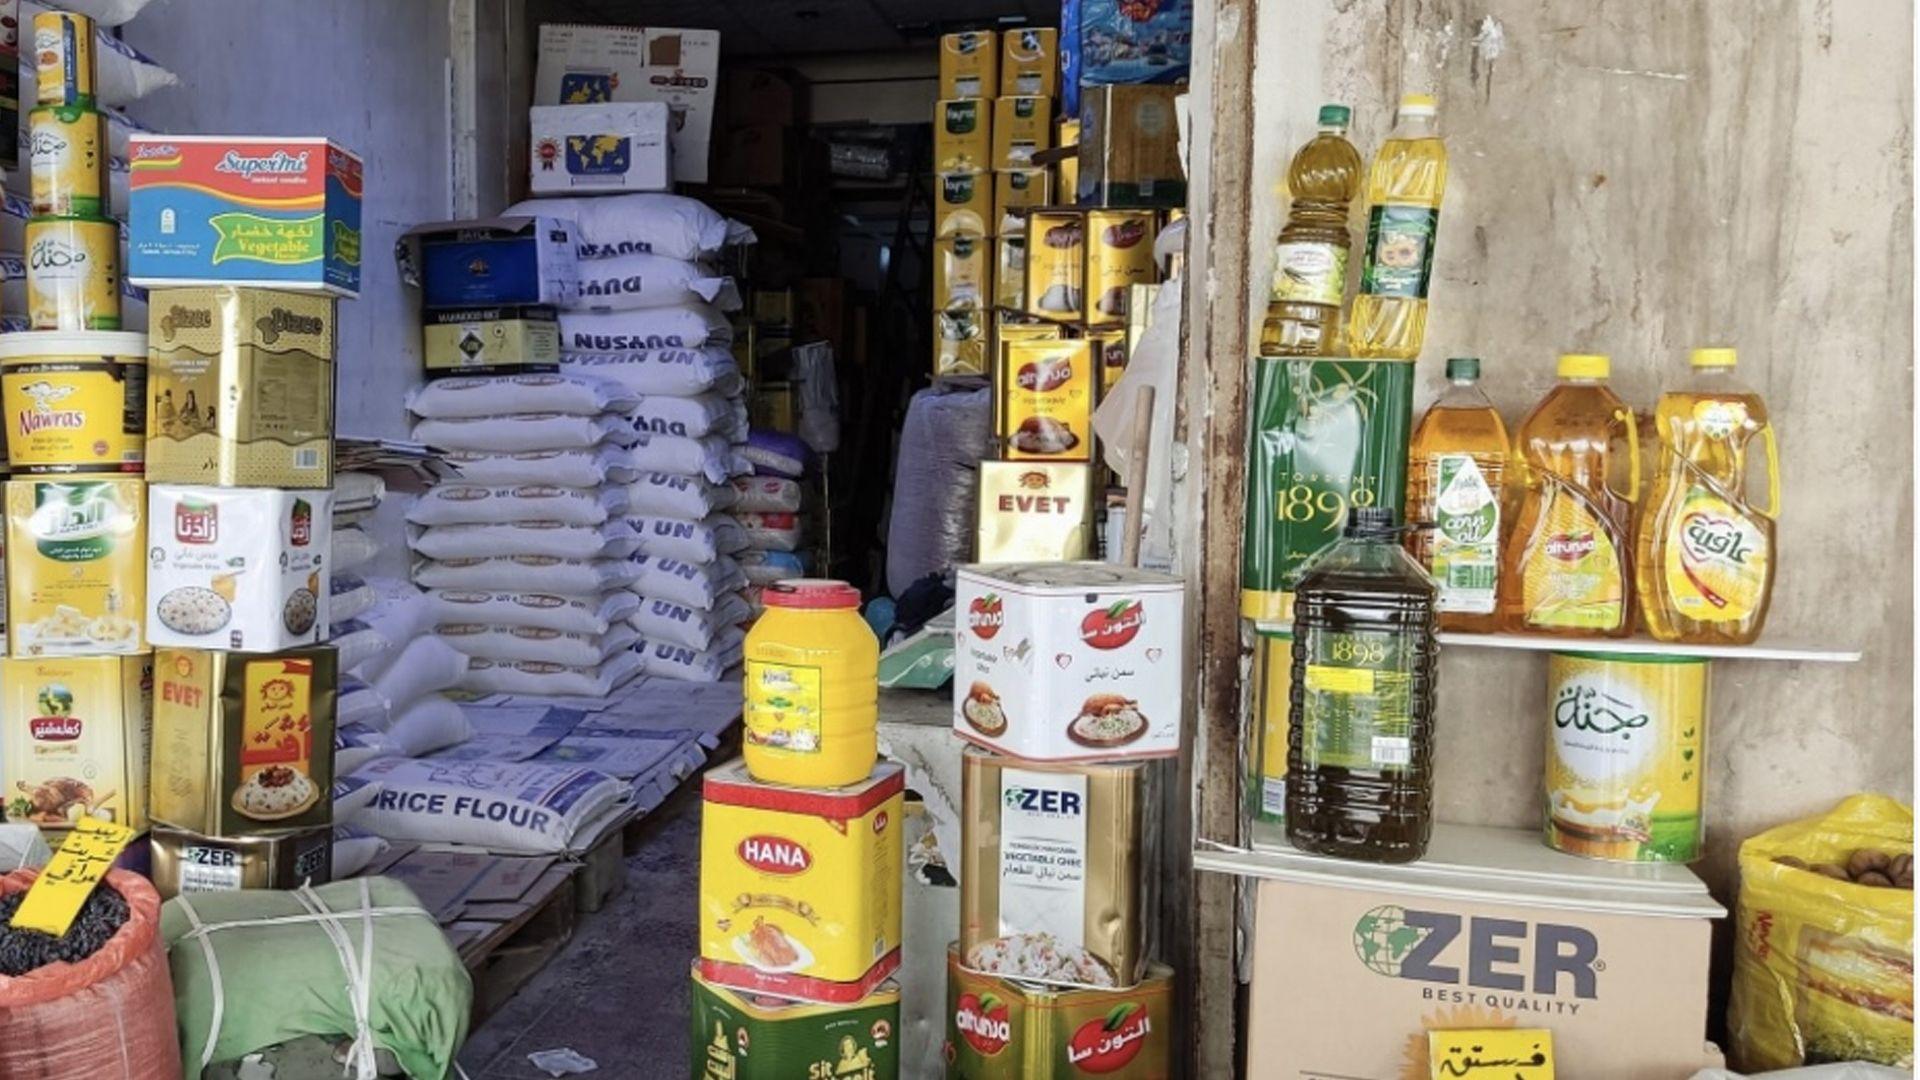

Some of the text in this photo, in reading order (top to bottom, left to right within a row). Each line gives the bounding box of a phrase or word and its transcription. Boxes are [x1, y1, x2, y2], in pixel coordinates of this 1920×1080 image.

[19, 409, 84, 437] Nawras
[998, 494, 1071, 515] EVET
[654, 519, 694, 539] UN
[1445, 513, 1488, 530] corn
[1457, 526, 1483, 543] oil
[1332, 636, 1385, 667] 1898
[162, 681, 202, 709] EVET
[379, 788, 550, 834] RICE FLOUR
[744, 840, 806, 868] HANA
[1422, 986, 1581, 1016] BEST QUALITY
